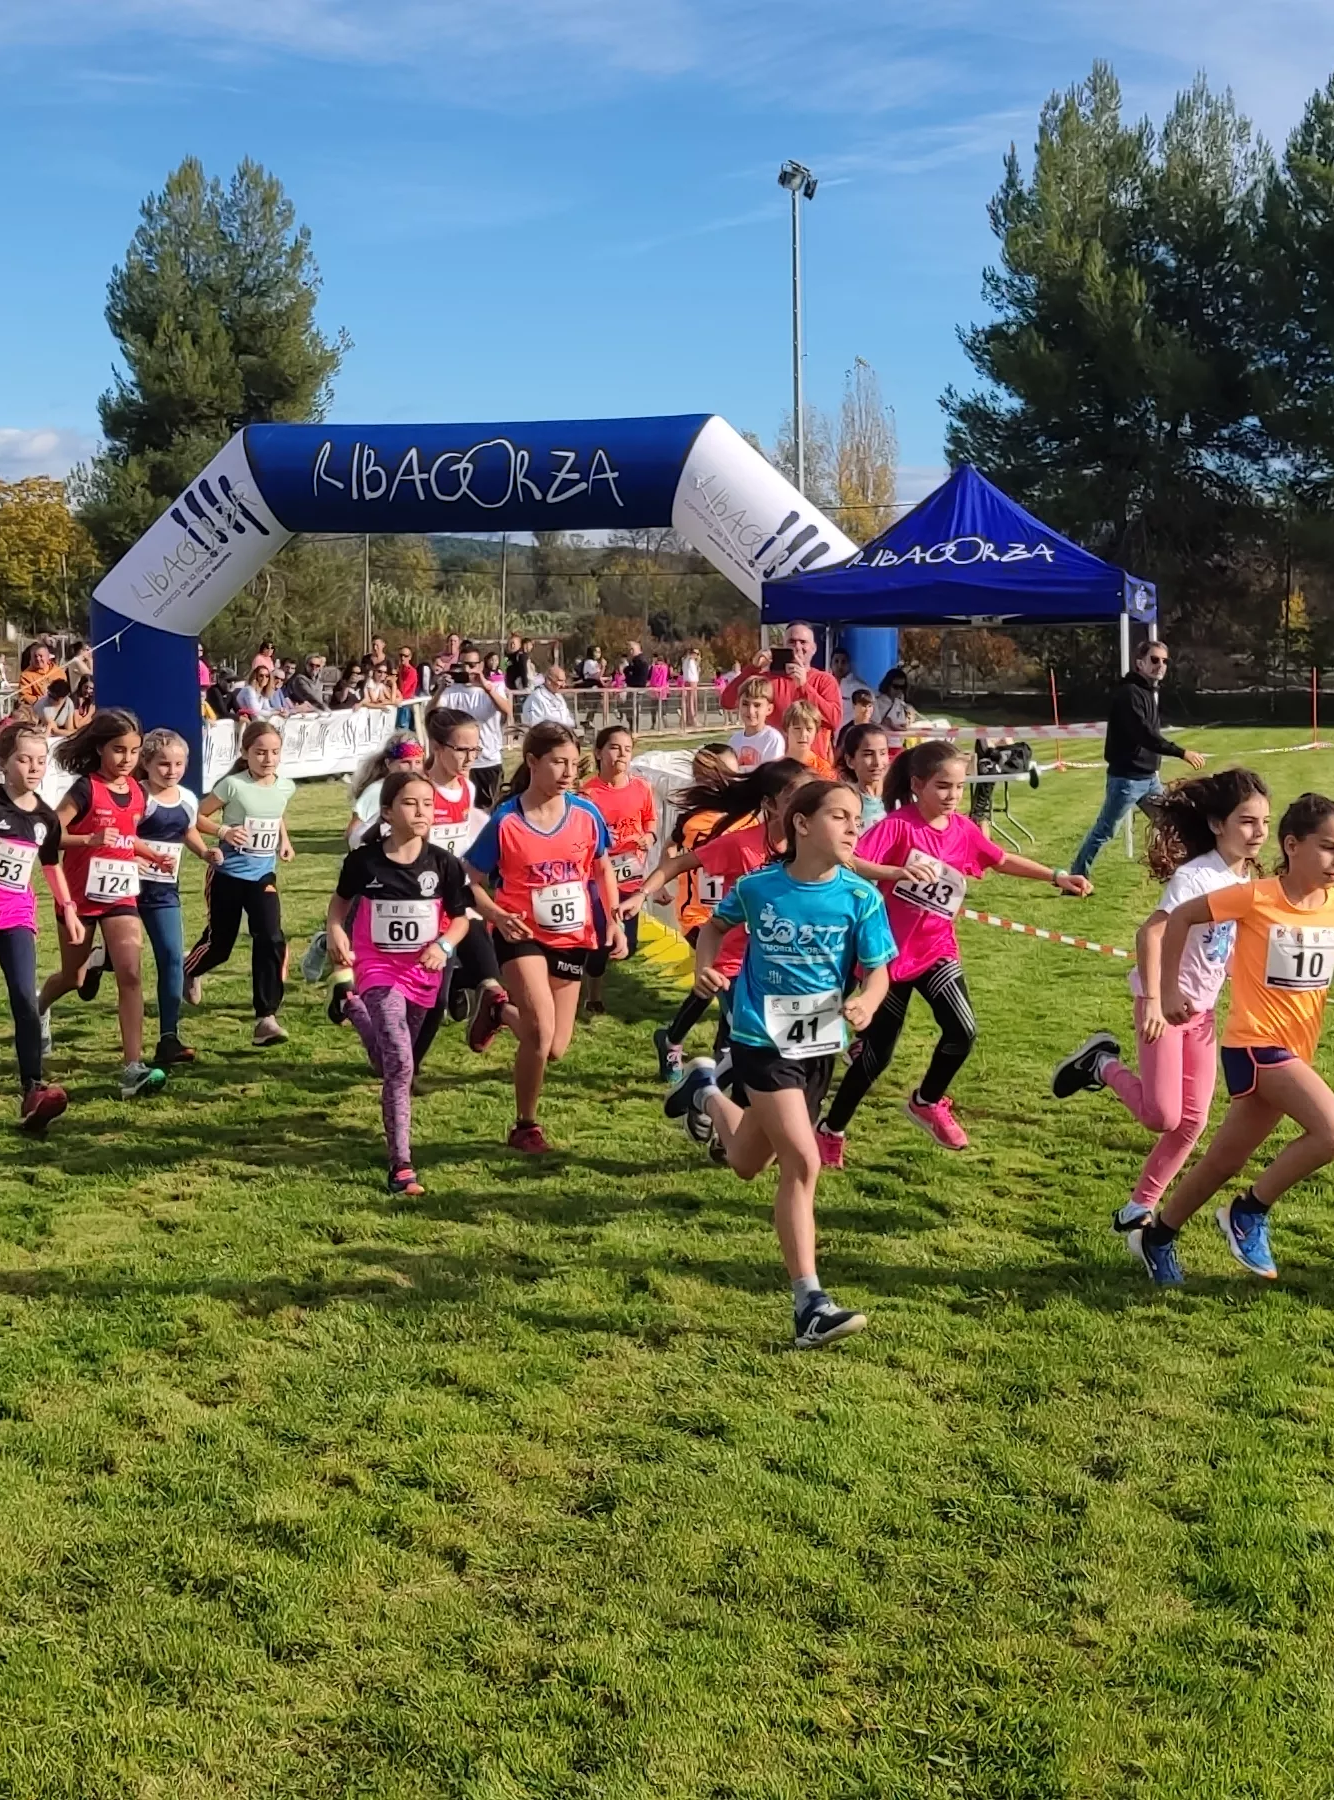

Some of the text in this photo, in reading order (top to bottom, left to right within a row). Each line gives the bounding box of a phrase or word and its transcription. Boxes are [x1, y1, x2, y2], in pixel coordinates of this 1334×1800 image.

[313, 438, 624, 508] RIBAGORZA
[845, 536, 1054, 569] RIBAGORZA
[251, 832, 277, 849] 107
[97, 876, 132, 895] 124
[551, 901, 575, 923] 95
[388, 920, 419, 942] 60
[556, 960, 584, 976] NASA
[1292, 951, 1324, 978] 10
[786, 1016, 819, 1044] 41
